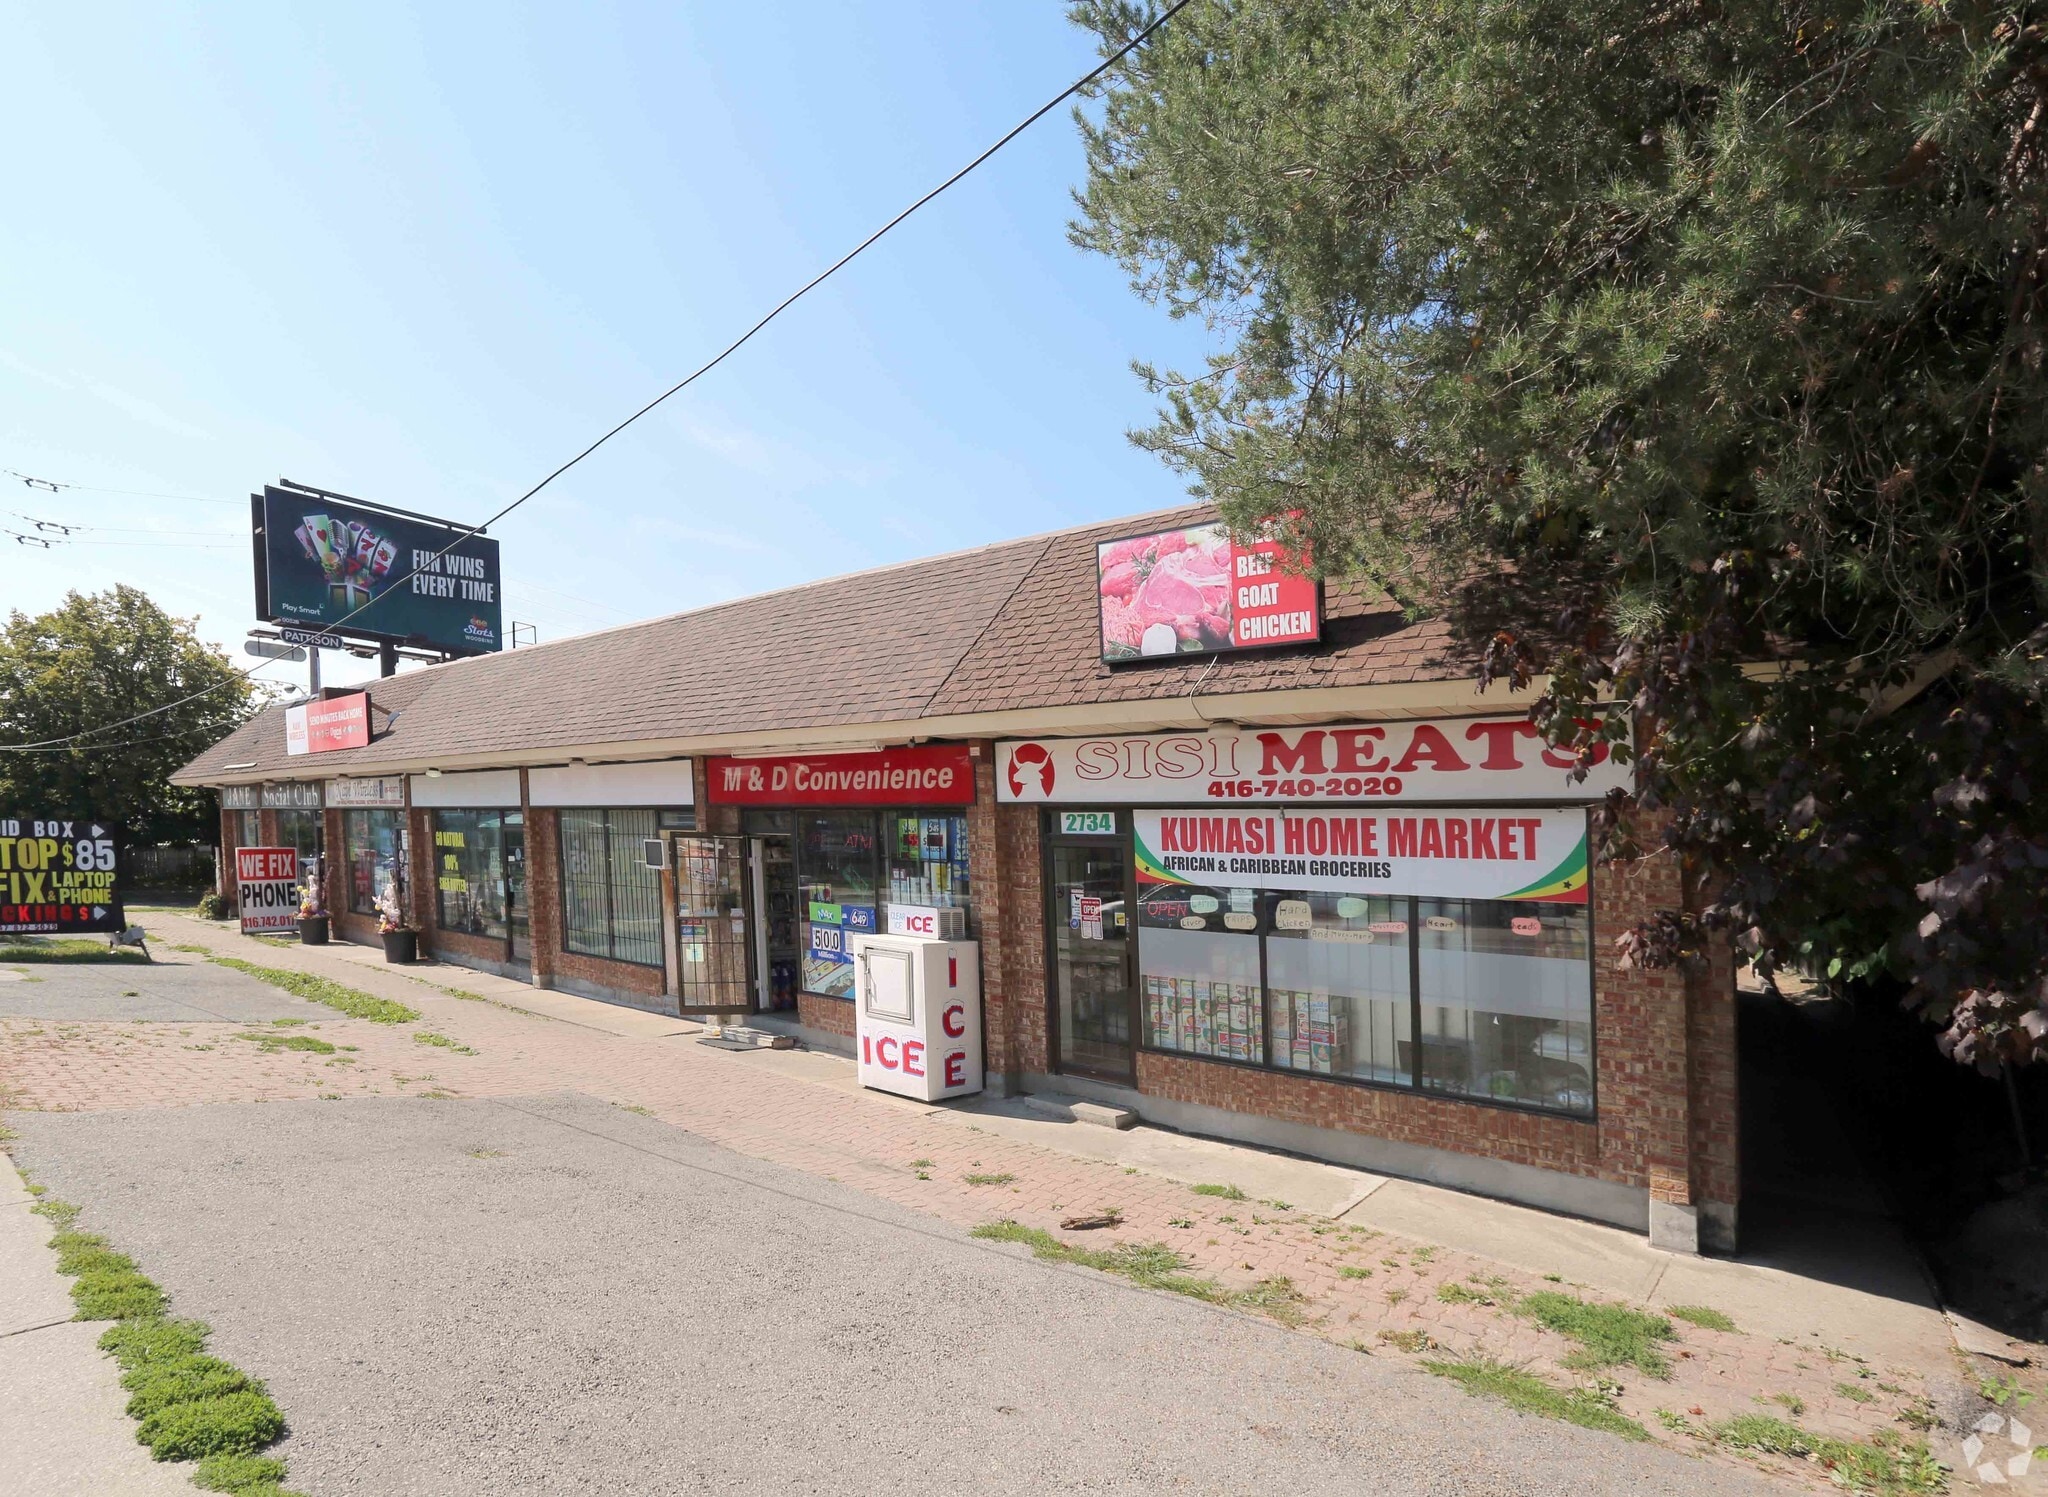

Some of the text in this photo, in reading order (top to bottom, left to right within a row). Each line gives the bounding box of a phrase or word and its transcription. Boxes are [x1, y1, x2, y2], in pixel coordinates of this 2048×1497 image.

[413, 549, 485, 579] FUN WINS
[413, 574, 494, 602] EVERY TIME
[1238, 583, 1279, 609] GOAT
[282, 603, 321, 615] Play Smart
[464, 624, 495, 638] Slots
[1239, 611, 1312, 641] CHICKEN
[285, 631, 340, 647] PATTISON
[1075, 718, 1609, 781] SISI MEATS
[723, 762, 954, 791] M & D Convenience
[227, 786, 251, 806] JANE
[263, 783, 319, 806] Social Club
[1207, 777, 1402, 797] 416-740-2020
[34, 821, 74, 838] BOX
[1065, 813, 1111, 832] 2734
[1161, 816, 1542, 861] KUMASI HOME MARKET
[241, 854, 294, 877] WE FIX
[1163, 855, 1392, 879] AFRICAN & CARIBBEAN GROCERIES
[52, 871, 116, 888] LAPTOP
[47, 888, 112, 904] & PHONE
[242, 882, 297, 908] PHONE
[891, 911, 906, 921] CLEAR
[1147, 901, 1187, 916] OPEN
[1280, 905, 1308, 916] Hard
[894, 921, 903, 930] ICE
[906, 915, 934, 933] ICE
[1427, 918, 1454, 928] Heart
[941, 948, 967, 1089] ICE
[862, 1030, 925, 1078] ICE
